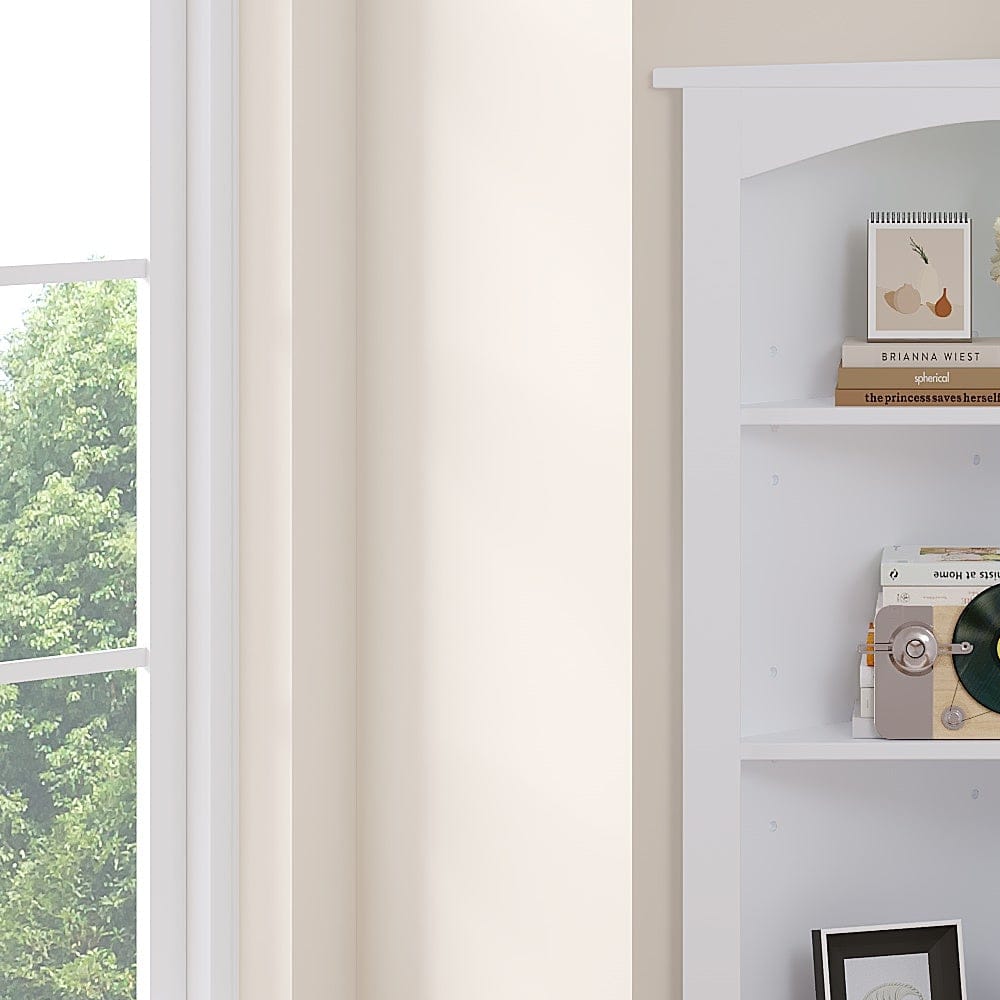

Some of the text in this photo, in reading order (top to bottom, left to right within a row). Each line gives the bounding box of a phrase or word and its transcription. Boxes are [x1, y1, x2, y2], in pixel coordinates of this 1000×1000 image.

[881, 352, 980, 362] BRIANNA WIEST
[914, 372, 950, 386] spherical
[865, 393, 884, 403] the
[885, 394, 931, 405] princess
[932, 394, 962, 403] saves
[933, 571, 962, 580] Home
[963, 571, 976, 580] at
